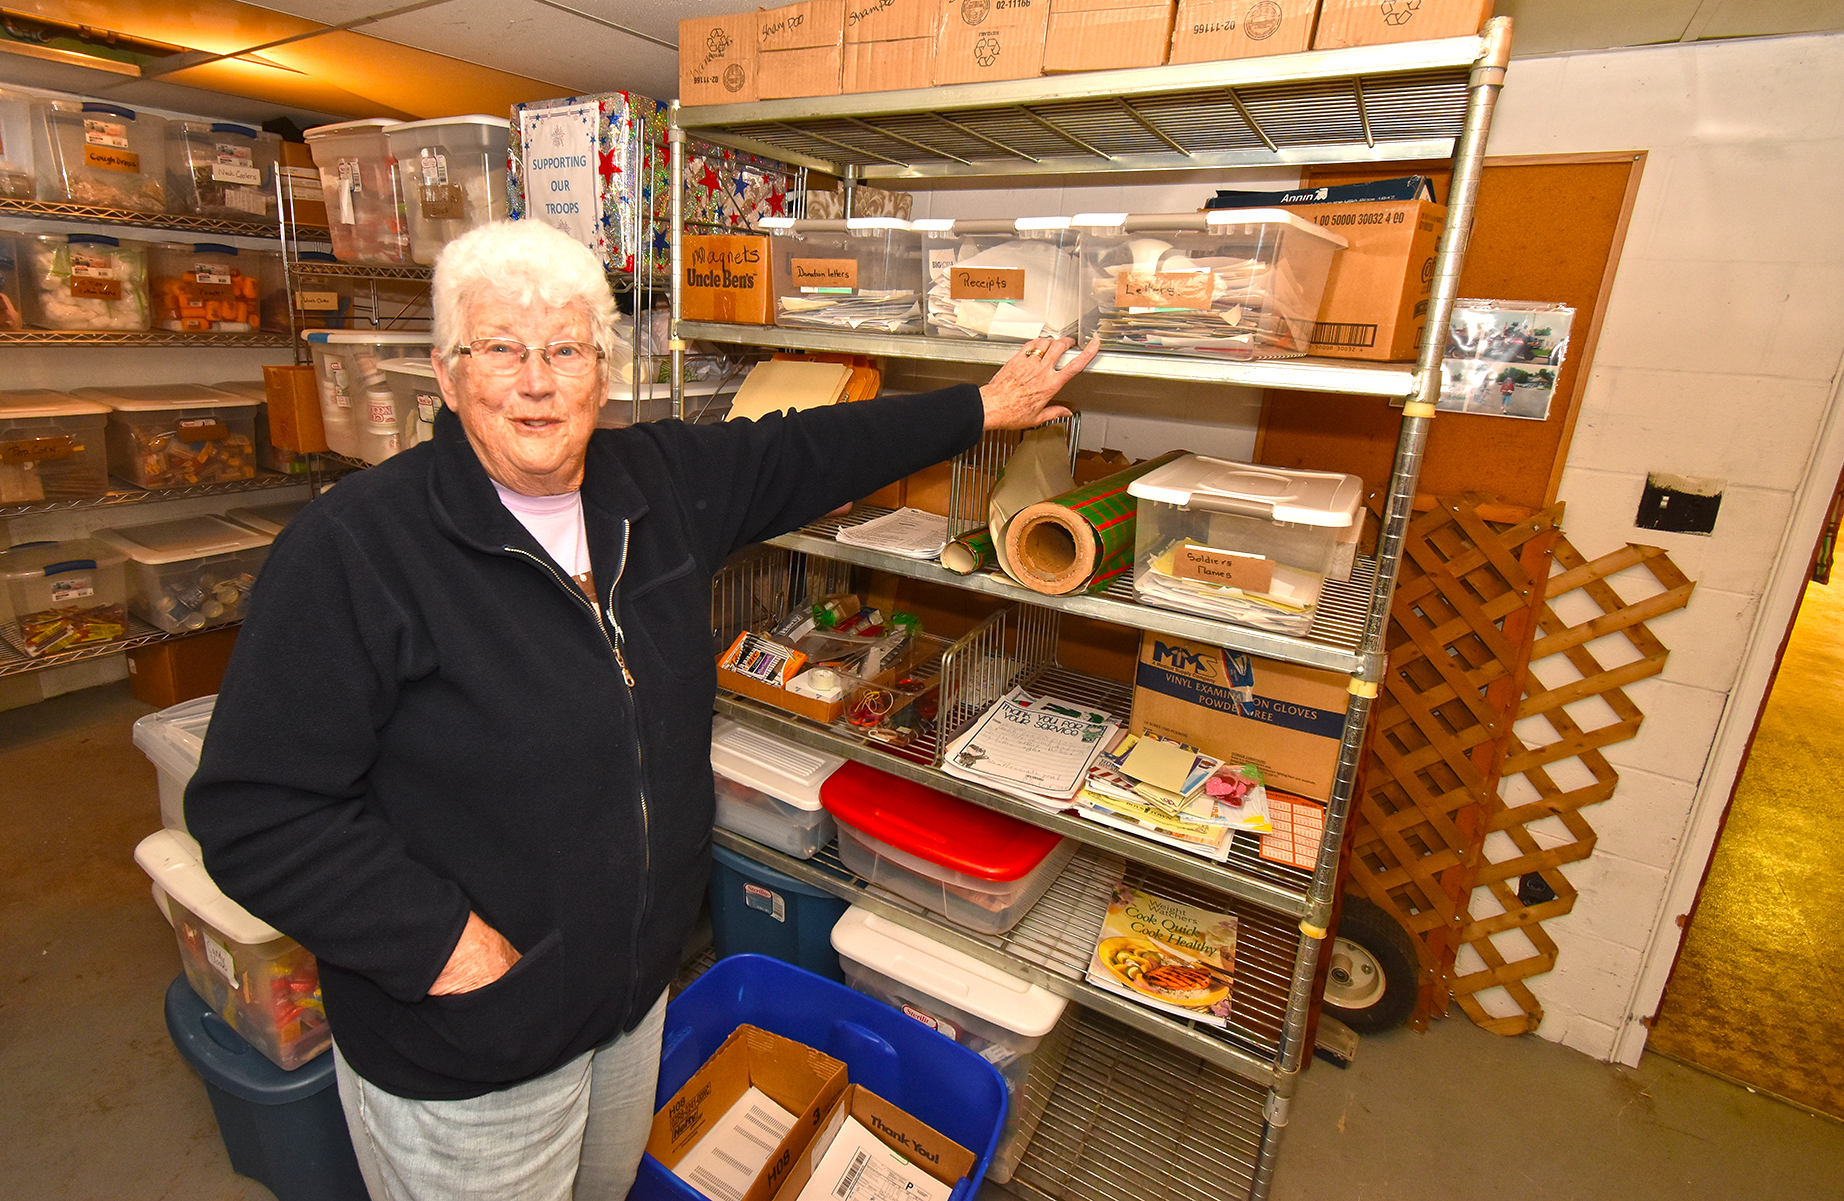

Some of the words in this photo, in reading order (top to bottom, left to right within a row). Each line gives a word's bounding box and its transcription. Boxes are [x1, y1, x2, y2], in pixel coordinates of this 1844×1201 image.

[1194, 21, 1235, 34] 02-11166
[532, 155, 586, 170] SUPPORTING
[551, 180, 570, 192] OUR
[1281, 192, 1313, 203] Annin
[545, 202, 579, 214] TROOPS
[1331, 214, 1356, 225] 50000
[1358, 213, 1382, 224] 30032
[692, 245, 760, 272] Magnets
[687, 268, 721, 287] Uncle
[959, 272, 1007, 291] Receipts
[1187, 552, 1232, 566] Soldiers
[747, 650, 759, 666] BIC
[1156, 662, 1174, 671] Medical
[1175, 667, 1191, 676] Supply
[1192, 672, 1216, 684] Company
[1166, 674, 1192, 688] VINYL
[1196, 684, 1270, 708] EXAMINAON
[1273, 703, 1318, 720] GLOVES
[1199, 695, 1238, 712] POWDE
[1252, 708, 1273, 721] REE
[1150, 899, 1186, 916] Weight
[1150, 905, 1198, 925] Watchers
[1125, 906, 1158, 926] Cook
[1161, 918, 1200, 938] Quick
[1130, 922, 1164, 940] Cook
[1168, 935, 1217, 957] Healthy
[813, 1107, 820, 1125] 3
[871, 1115, 910, 1147] Thank
[912, 1140, 939, 1164] You!
[768, 1149, 790, 1188] H08
[906, 1182, 914, 1190] P
